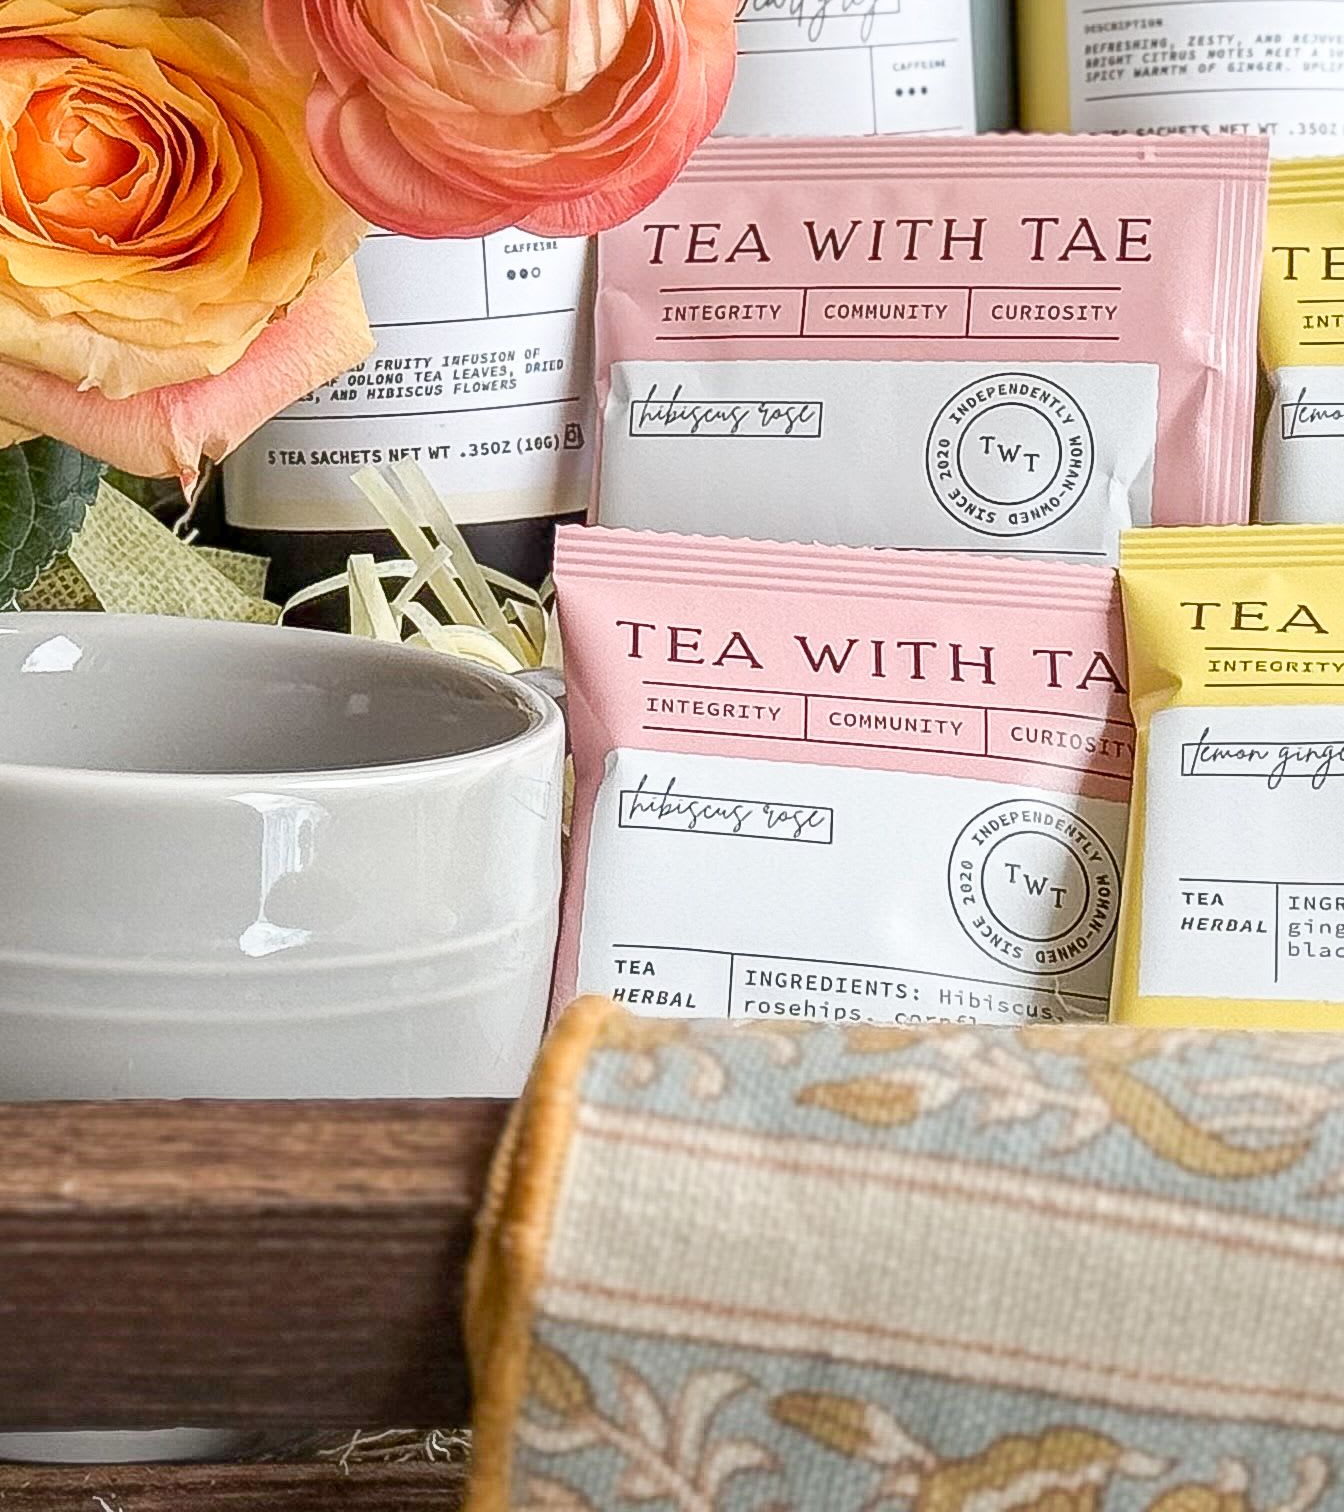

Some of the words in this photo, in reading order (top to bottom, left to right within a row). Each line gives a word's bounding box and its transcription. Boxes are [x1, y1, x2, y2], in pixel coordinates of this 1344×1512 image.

[504, 240, 558, 254] CAFFEINE
[643, 223, 771, 265] TEA
[802, 217, 988, 263] WITH
[1021, 217, 1153, 262] TAE
[662, 304, 782, 322] INTEGRITY
[823, 304, 948, 321] COMMUNITY
[991, 305, 1118, 321] CURIOSITY
[348, 372, 403, 386] OOLONG
[414, 370, 443, 383] TEA
[453, 364, 515, 380] LEAVES,
[525, 359, 564, 375] DRIED
[374, 357, 432, 371] FRUITY
[441, 351, 515, 368] INFUSION
[524, 348, 540, 360] OF
[329, 389, 357, 401] AND
[366, 384, 443, 399] HIBISCUS
[453, 379, 517, 394] FLOWERS
[638, 384, 750, 434] hibiscus
[758, 402, 816, 435] rose
[949, 383, 1076, 425] INDEPENDENTLY
[268, 450, 276, 465] 5
[280, 450, 306, 465] TEA
[310, 449, 382, 465] SACHETS
[428, 446, 451, 460] WT
[517, 434, 560, 453] (10G)
[937, 438, 953, 481] 2020
[979, 436, 1040, 472] TWT
[1008, 435, 1083, 525] WOMAN-OWNED
[948, 488, 997, 524] SINCE
[1180, 601, 1329, 634] TEA
[616, 620, 764, 670] TEA
[794, 635, 996, 685] WITH
[647, 697, 781, 721] INTEGRITY
[829, 711, 963, 737] COMMUNITY
[1190, 726, 1269, 775] lemon
[629, 774, 752, 833] hibiscus
[763, 803, 825, 838] rose
[971, 811, 1103, 862] INDEPENDENTLY
[960, 860, 975, 905] 2020
[1005, 863, 1067, 908] TWT
[1181, 892, 1226, 907] TEA
[972, 916, 1023, 958] SINCE
[1036, 874, 1111, 963] WOMAN-OWNED
[1180, 917, 1268, 934] HERBAL
[614, 959, 656, 977] TEA
[612, 987, 696, 1008] HERBAL
[745, 969, 920, 1001] INGREDIENTS:
[939, 988, 1064, 1023] Hibiscus,
